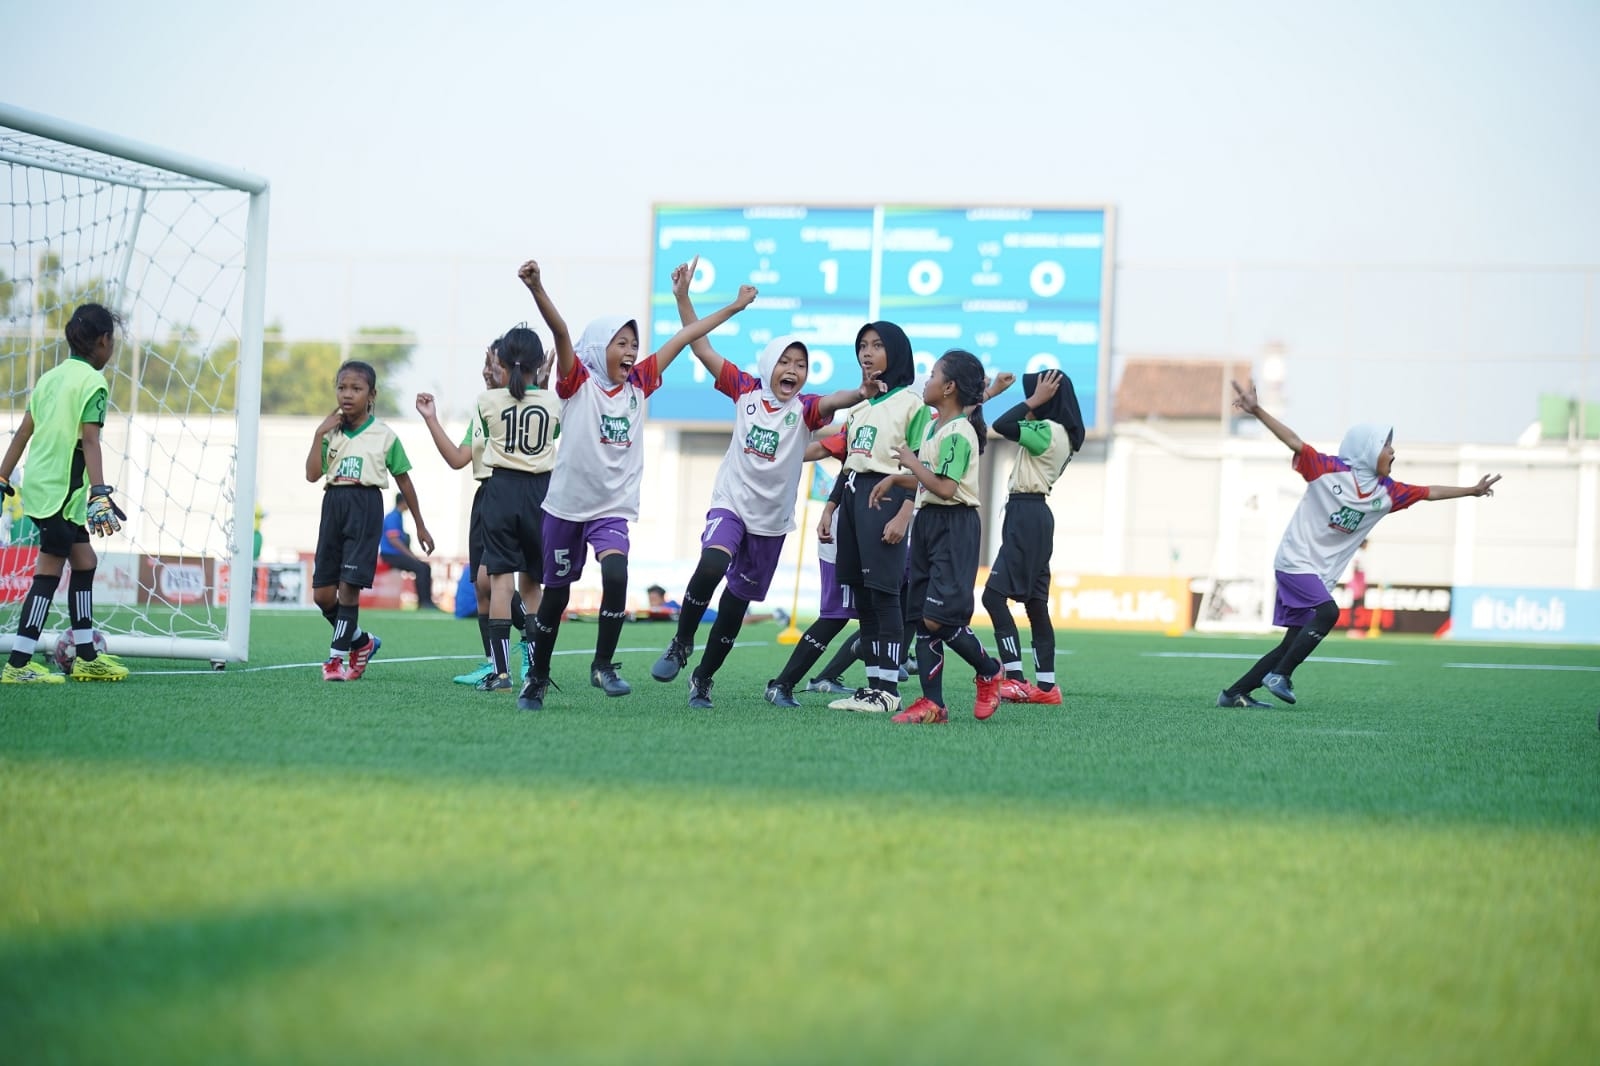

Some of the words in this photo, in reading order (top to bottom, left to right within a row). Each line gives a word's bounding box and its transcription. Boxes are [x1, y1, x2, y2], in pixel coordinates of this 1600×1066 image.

[688, 257, 716, 293] 0
[819, 259, 839, 294] 1
[908, 259, 943, 296] 0
[1030, 260, 1066, 297] 0
[501, 405, 549, 455] 10
[753, 429, 776, 446] Milk
[754, 440, 775, 454] Life
[703, 517, 723, 541] 7
[554, 549, 571, 576] 5
[841, 584, 856, 608] 1
[602, 610, 626, 618] SPEC
[804, 634, 826, 651] SPEC
